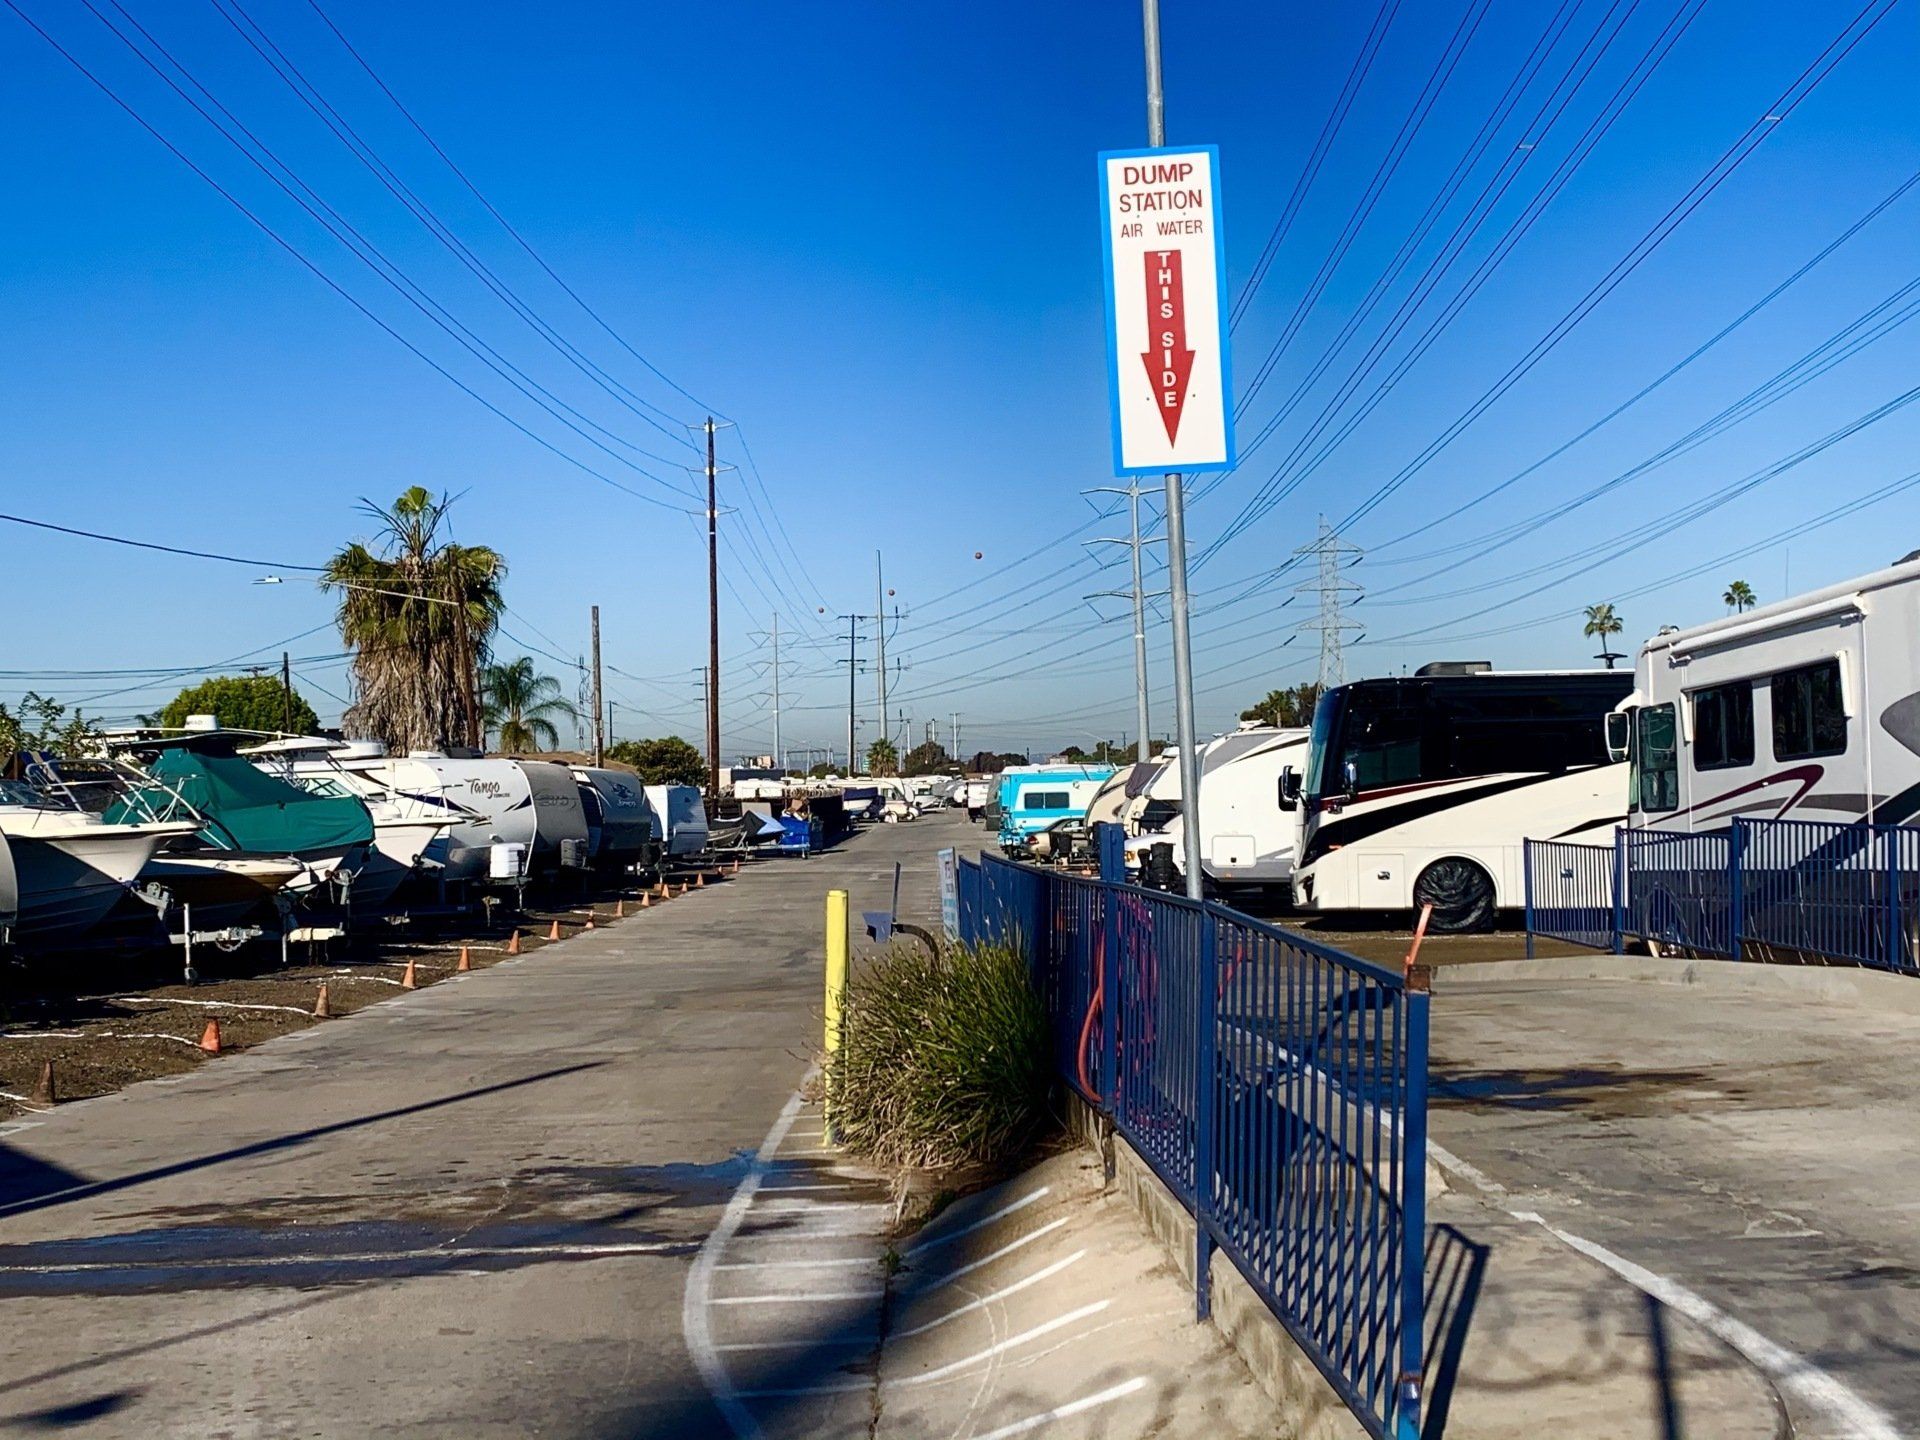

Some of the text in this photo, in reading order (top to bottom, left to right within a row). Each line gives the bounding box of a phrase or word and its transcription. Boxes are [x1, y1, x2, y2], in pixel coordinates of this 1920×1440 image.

[1124, 163, 1193, 185] DUMP
[1119, 189, 1203, 213] STATION
[1121, 219, 1203, 238] AIR WATER
[1157, 252, 1178, 408] THIS SIDE
[464, 778, 500, 799] Tango
